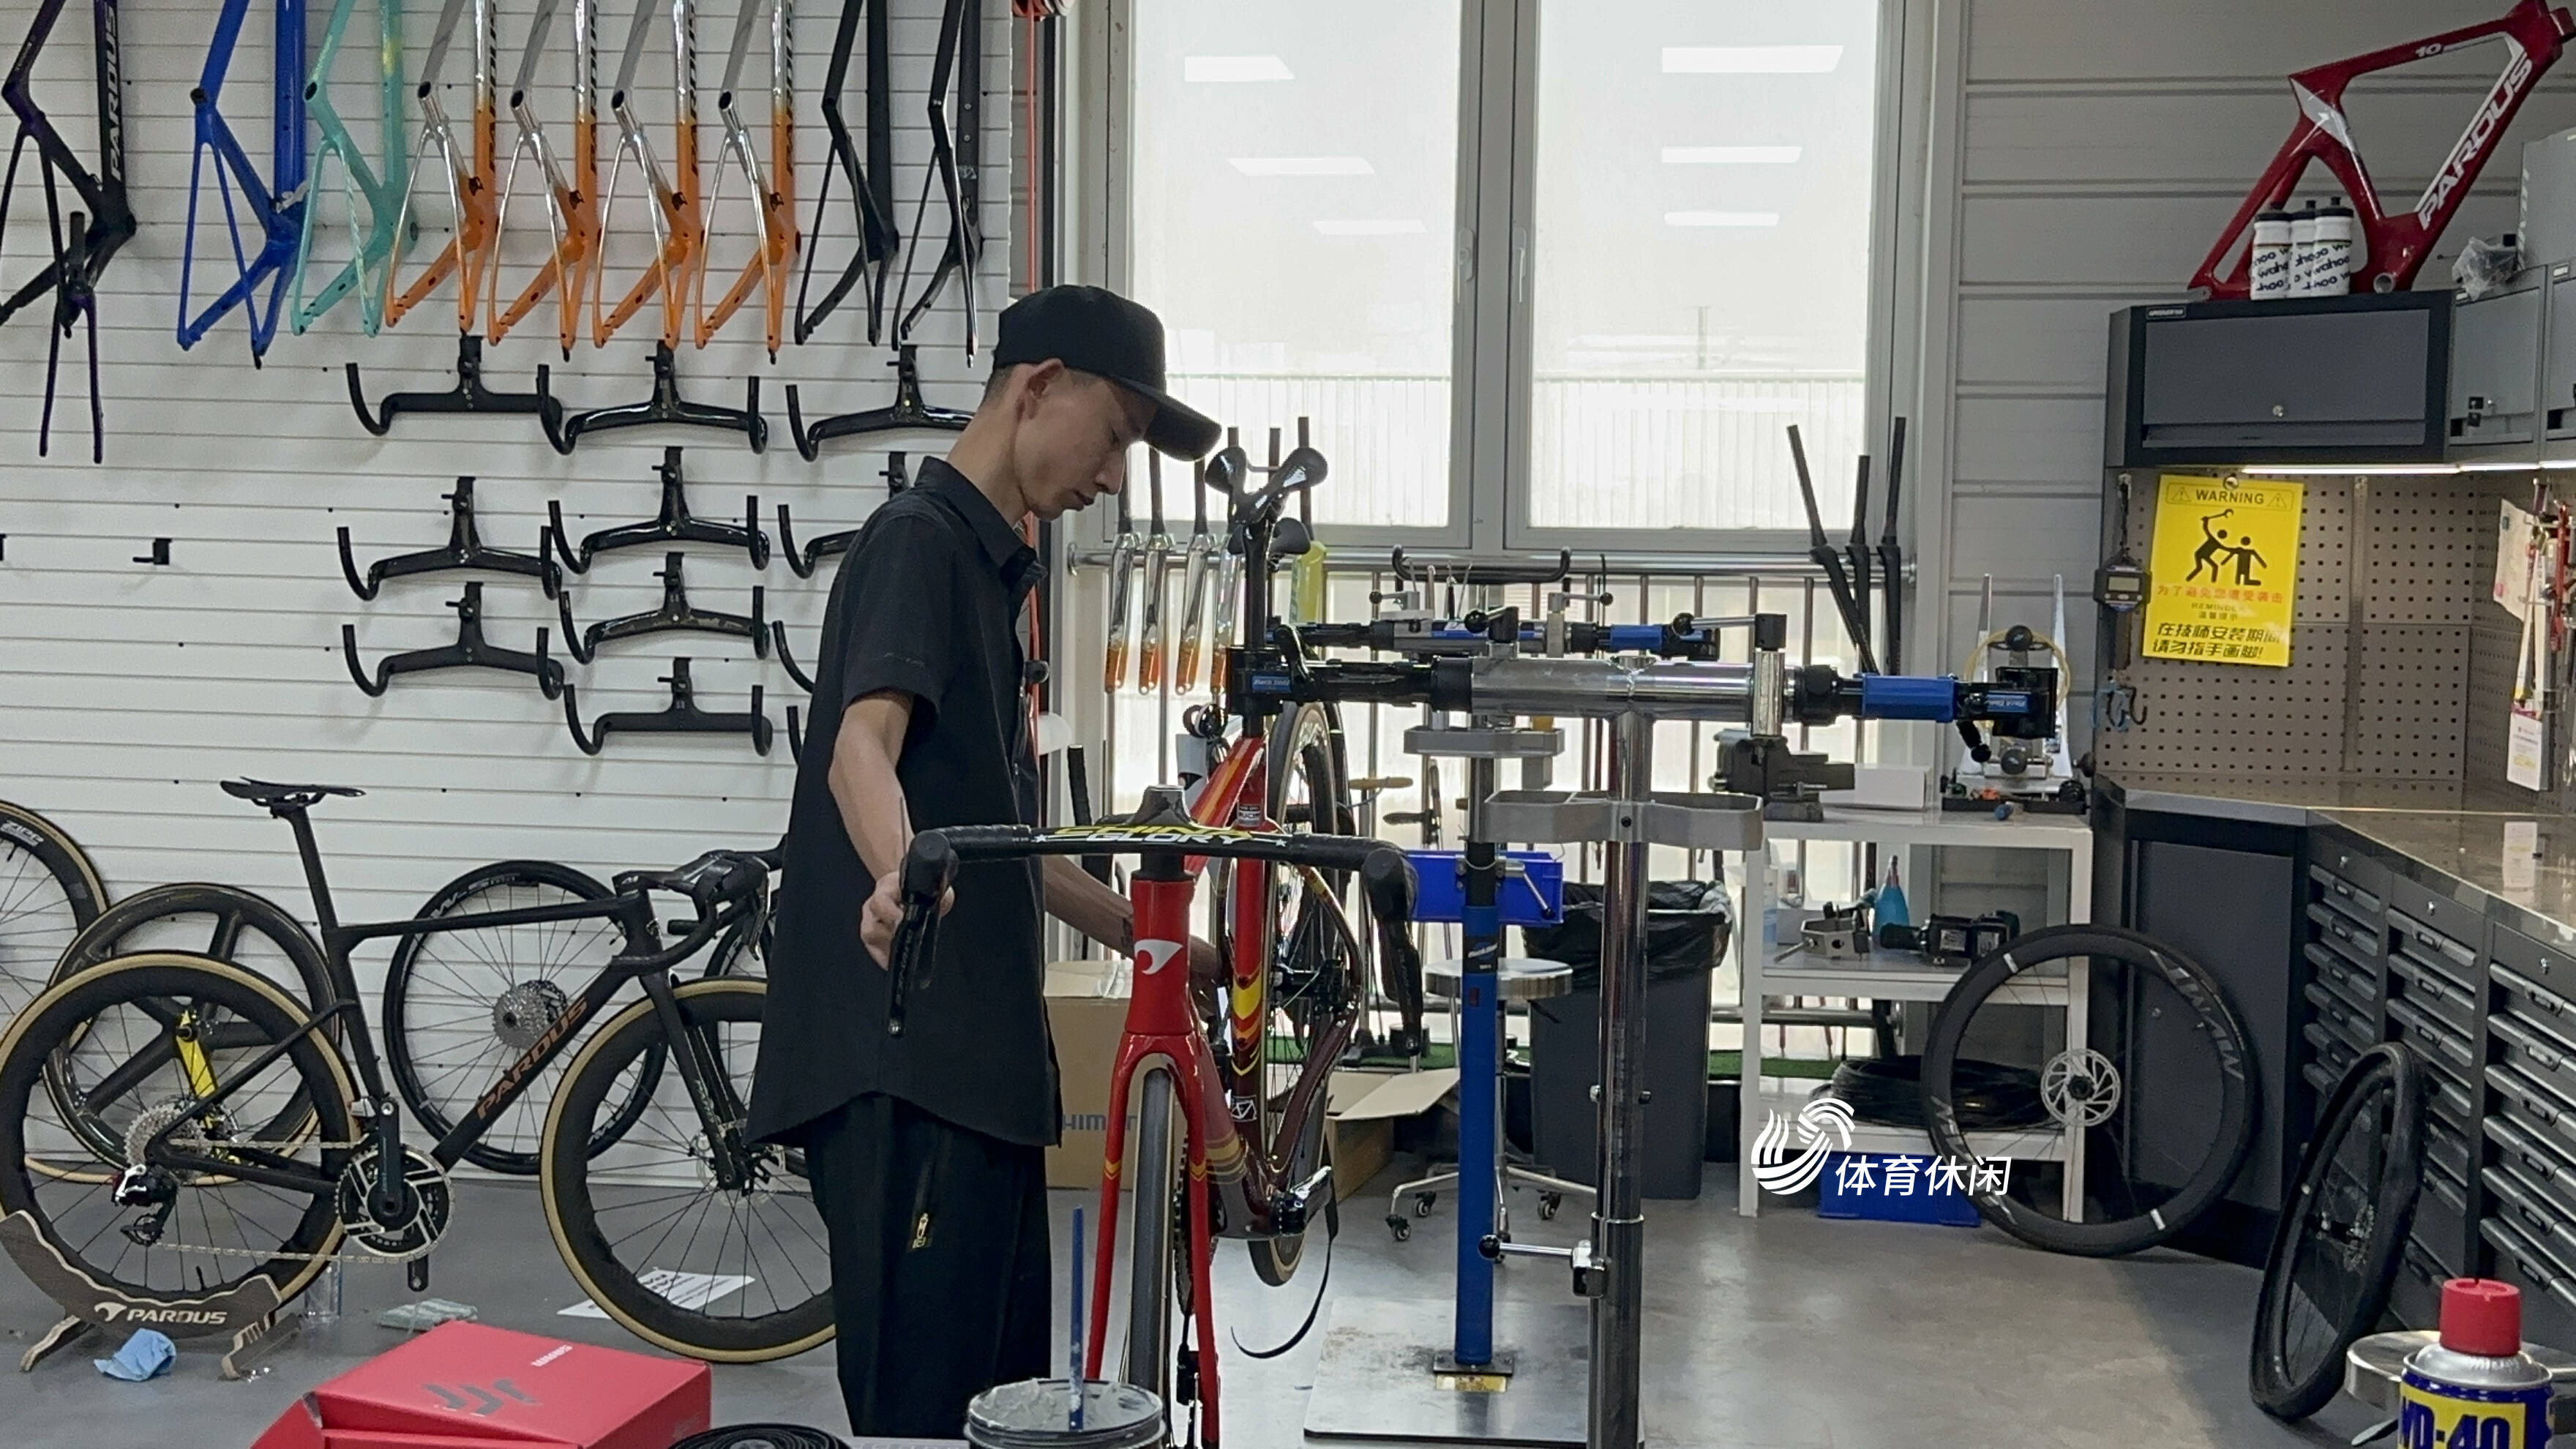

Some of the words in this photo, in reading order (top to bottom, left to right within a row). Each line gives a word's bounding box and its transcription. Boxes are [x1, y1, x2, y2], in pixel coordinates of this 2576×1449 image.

[2416, 42, 2442, 58] 10
[105, 1, 121, 181] PARDUS
[2417, 52, 2534, 231] PARDUS
[2196, 489, 2264, 504] WARNING
[1086, 834, 1244, 845] GLORY
[477, 997, 588, 1120] PARDUS
[127, 1308, 228, 1325] PARDUS
